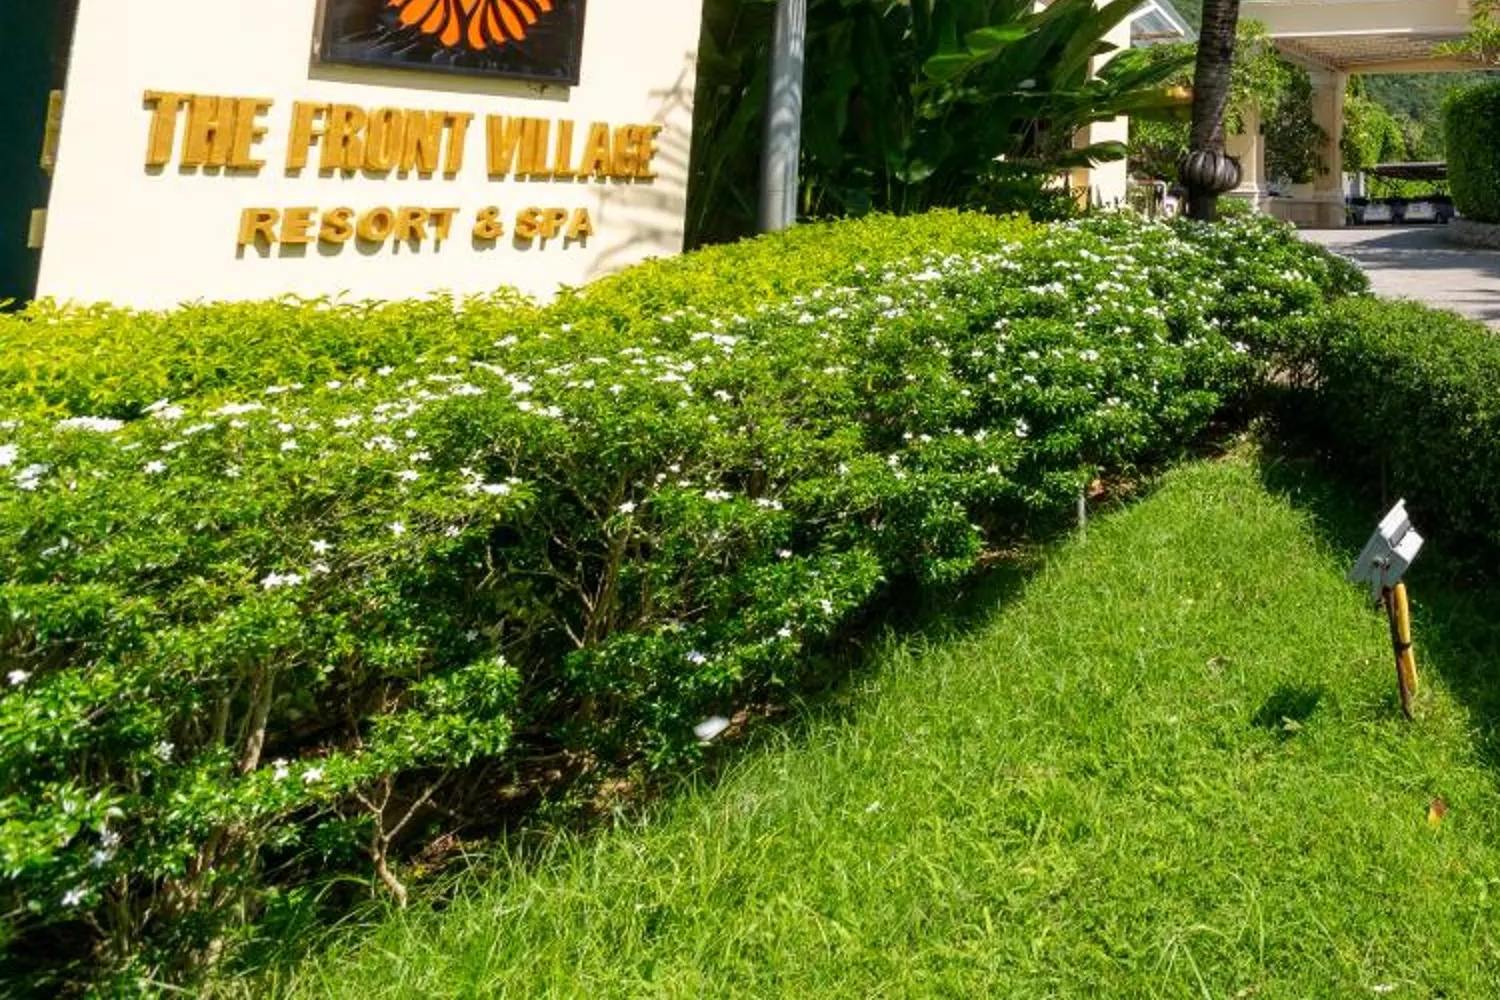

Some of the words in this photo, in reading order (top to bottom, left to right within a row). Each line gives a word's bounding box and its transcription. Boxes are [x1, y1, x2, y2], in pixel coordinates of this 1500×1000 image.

[143, 89, 274, 169] THE
[284, 100, 475, 176] FRONT
[486, 113, 662, 182] VILLAGE
[237, 206, 460, 245] RESORT
[473, 206, 504, 239] &
[514, 206, 594, 240] SPA
